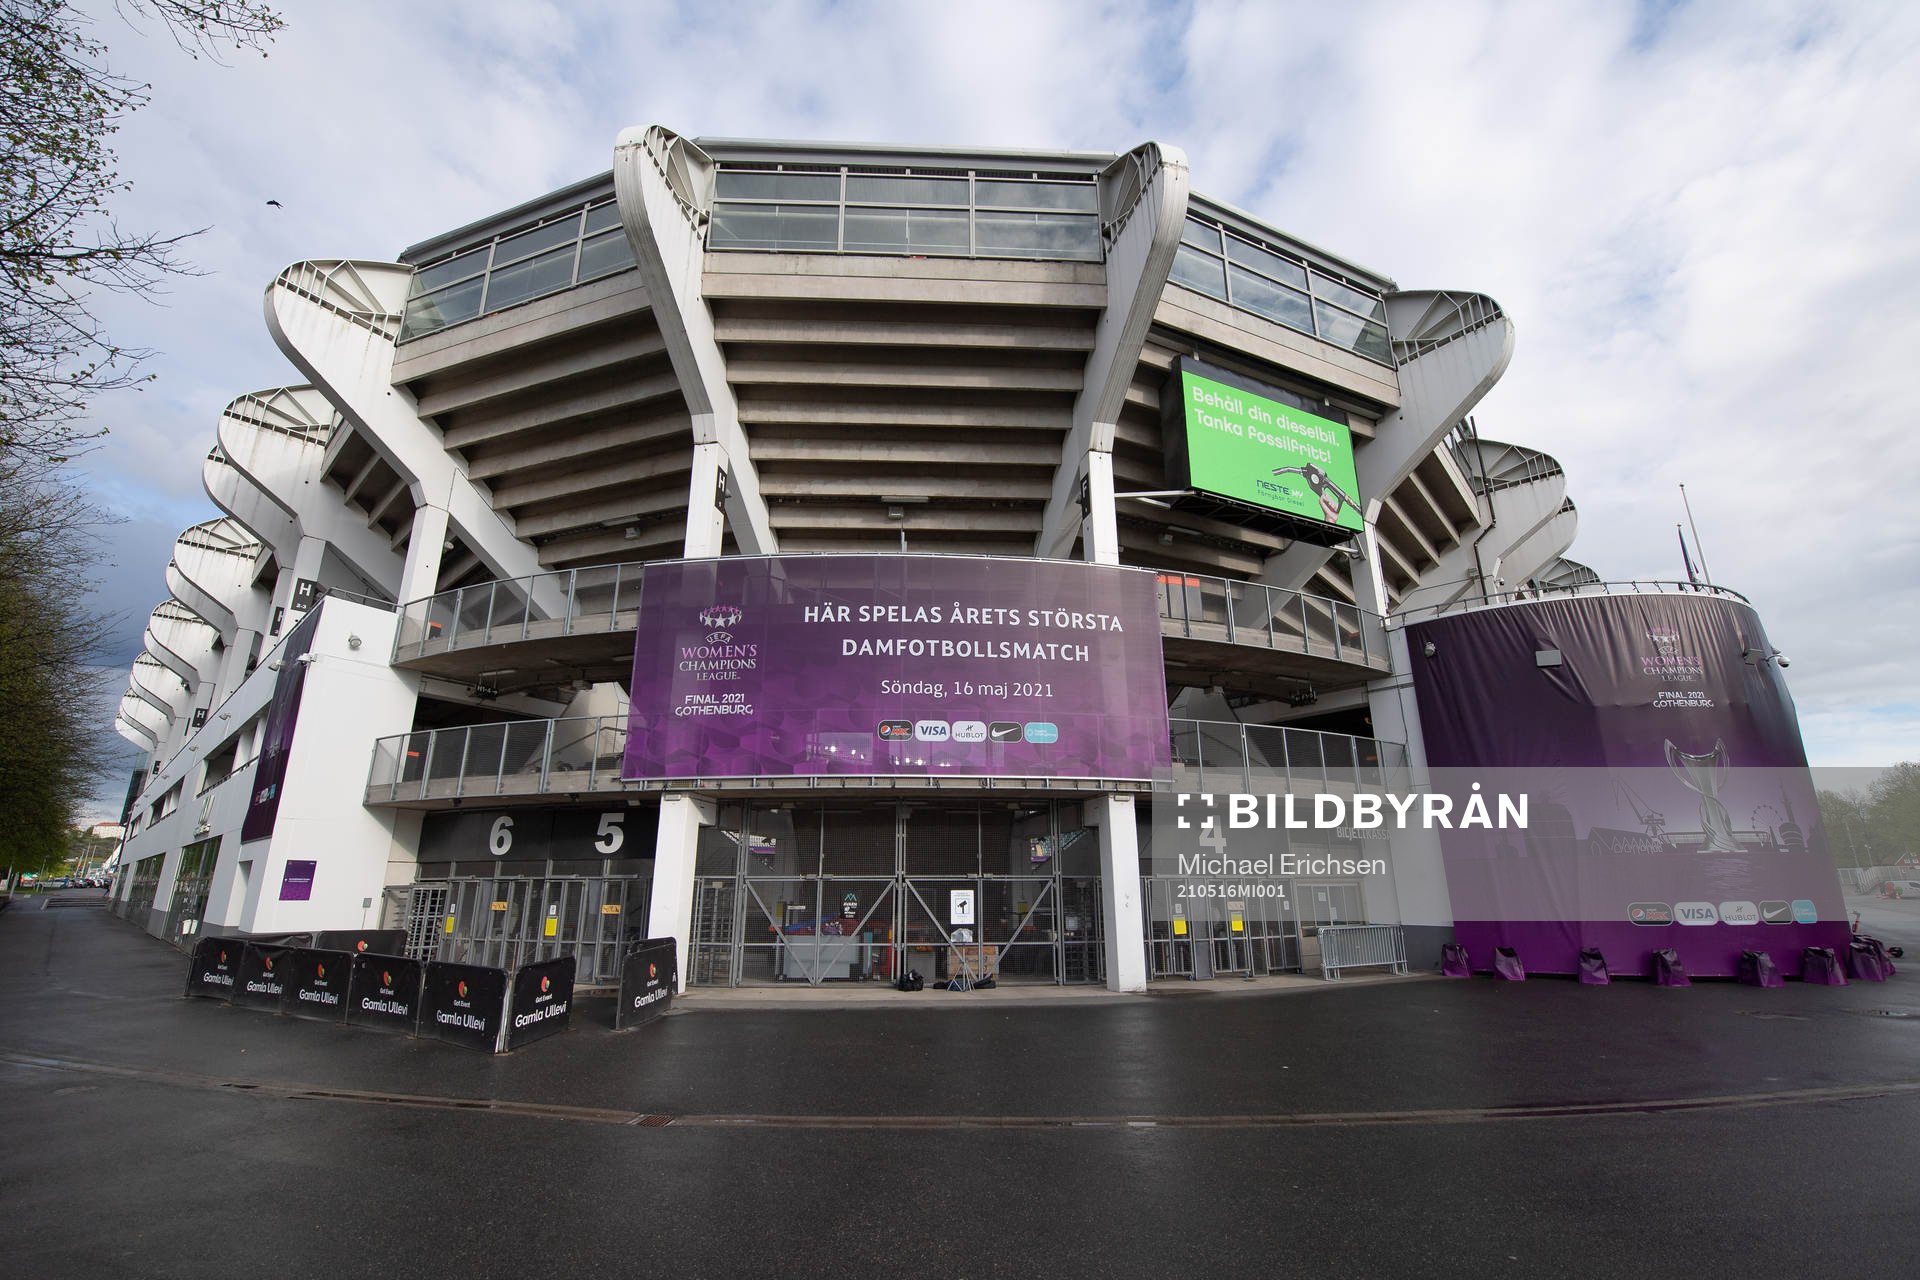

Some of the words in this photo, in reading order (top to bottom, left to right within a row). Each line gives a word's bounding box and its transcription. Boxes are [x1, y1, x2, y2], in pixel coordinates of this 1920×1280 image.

[1192, 386, 1243, 416] Behåll
[1248, 405, 1272, 425] din
[1276, 415, 1340, 447] dieselbil.
[1194, 408, 1243, 437] Tanka
[1248, 425, 1332, 464] fossilfritt!
[718, 472, 726, 492] H
[1082, 479, 1088, 499] F
[1256, 479, 1290, 496] NESTE
[299, 582, 312, 597] H
[804, 602, 850, 623] HÄR
[859, 605, 942, 623] SPELAS
[950, 601, 1021, 626] ÅRETS
[1028, 608, 1124, 632] STÖRSTA
[706, 633, 731, 643] UEFA
[682, 644, 758, 659] WOMEN'S
[842, 639, 1089, 662] DAMFOTBOLLSMATCH
[679, 659, 757, 671] CHAMPIONS
[696, 672, 737, 681] LEAGUE
[881, 680, 948, 699] Söndag,
[954, 681, 973, 695] 16
[978, 683, 1008, 699] maj
[1013, 683, 1053, 697] 2021
[685, 695, 719, 704] FINAL
[721, 693, 745, 703] 2021
[1653, 699, 1714, 708] GOTHENBURG
[196, 710, 206, 719] H
[675, 704, 753, 717] GOTHENBURG
[920, 726, 947, 736] VISA
[595, 813, 624, 854] 5
[1199, 800, 1227, 854] 4
[489, 816, 514, 856] 6
[1680, 908, 1714, 919] VISA
[247, 981, 267, 993] Gamla
[300, 989, 320, 1002] Gamla
[321, 992, 339, 1005] Ullevi
[634, 992, 655, 1008] Gamla
[362, 997, 387, 1012] Gamla
[388, 1001, 409, 1016] Ullevi
[515, 1008, 544, 1028] Gamla
[545, 1001, 568, 1018] Ullevi
[436, 1009, 462, 1026] Gamla
[463, 1014, 486, 1031] Ullevi
